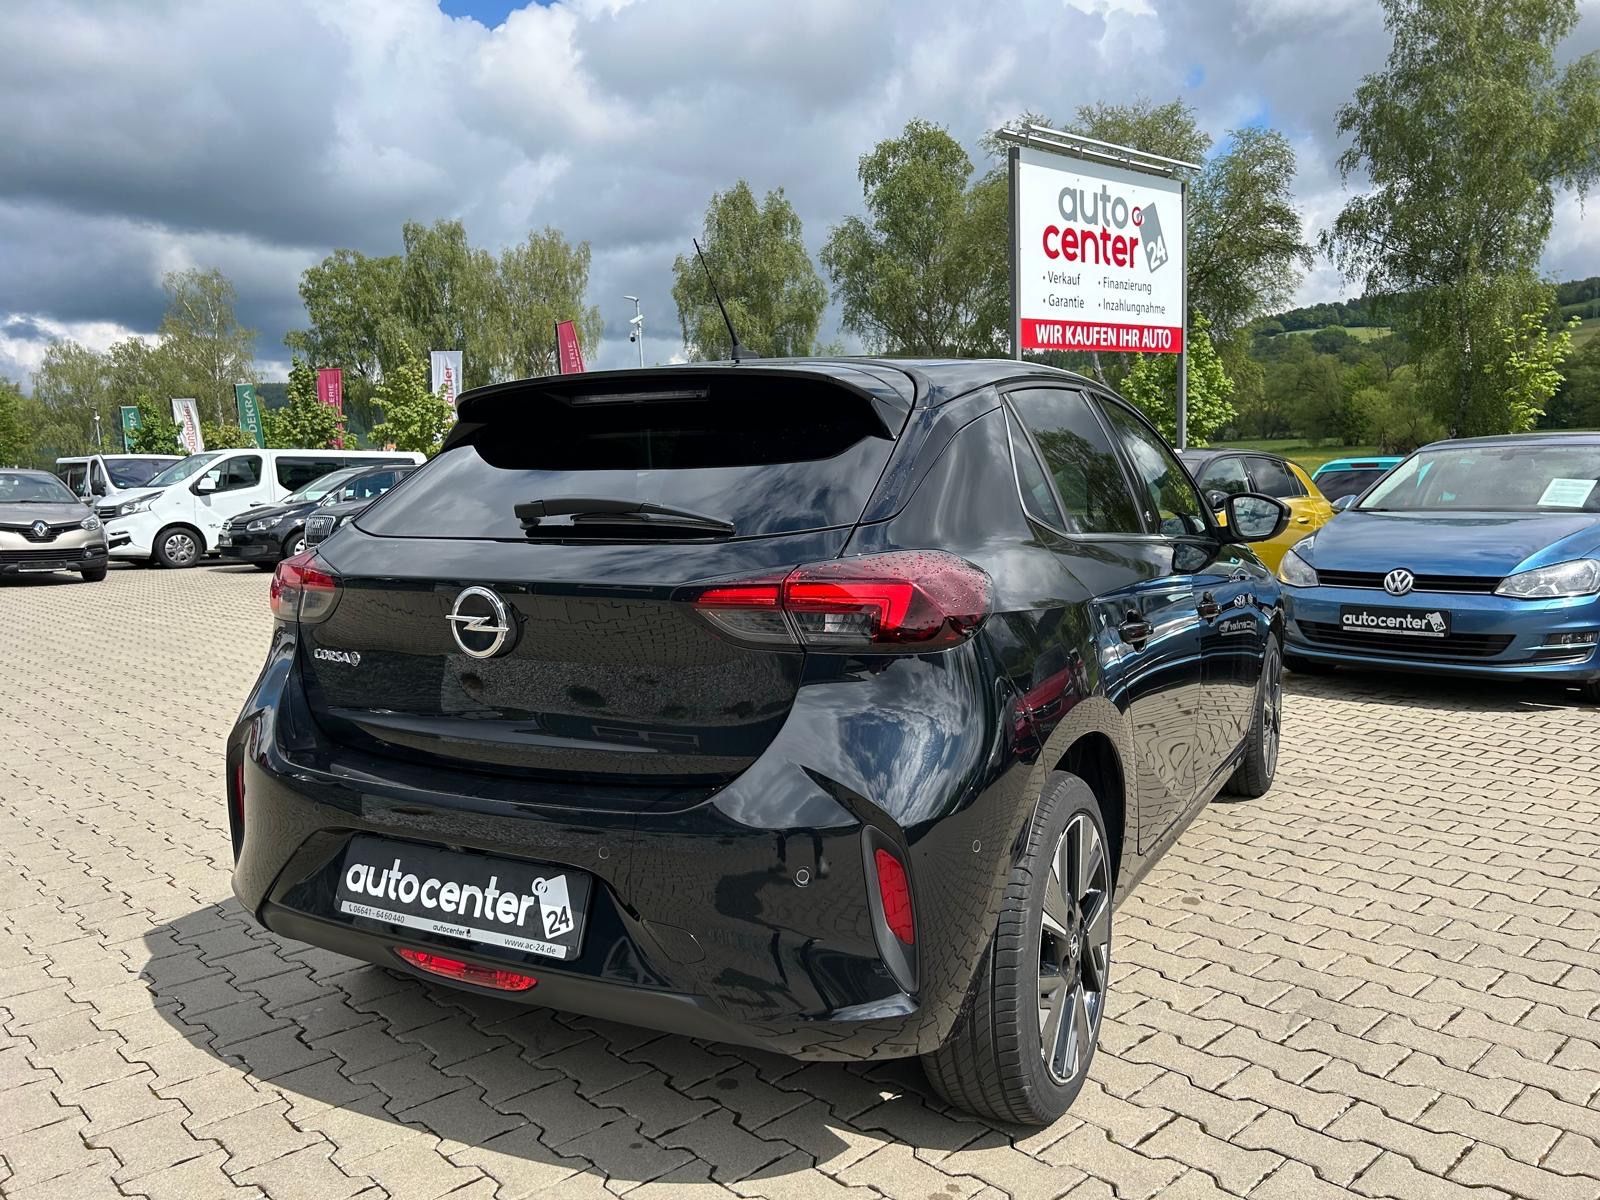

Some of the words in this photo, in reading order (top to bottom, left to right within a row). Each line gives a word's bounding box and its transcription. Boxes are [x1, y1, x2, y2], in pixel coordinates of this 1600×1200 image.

[1058, 184, 1128, 229] auto
[1042, 225, 1138, 268] center
[1147, 235, 1166, 268] 24
[1048, 271, 1081, 287] Verkauf
[1103, 278, 1152, 295] Finanzierung
[1048, 294, 1085, 309] Garantie
[1103, 299, 1166, 315] Inzahlungnahme
[1036, 324, 1062, 345] WIR
[1065, 326, 1117, 346] KAUFEN
[1119, 328, 1139, 347] IHR
[1142, 329, 1172, 348] AUTO
[243, 390, 258, 433] DEKRA
[1342, 611, 1428, 630] autocenter
[314, 648, 350, 664] CORSA
[345, 858, 535, 927] autocenter
[546, 906, 570, 935] 24
[432, 924, 465, 937] autocenter
[504, 938, 557, 954] www.ac-24.de
